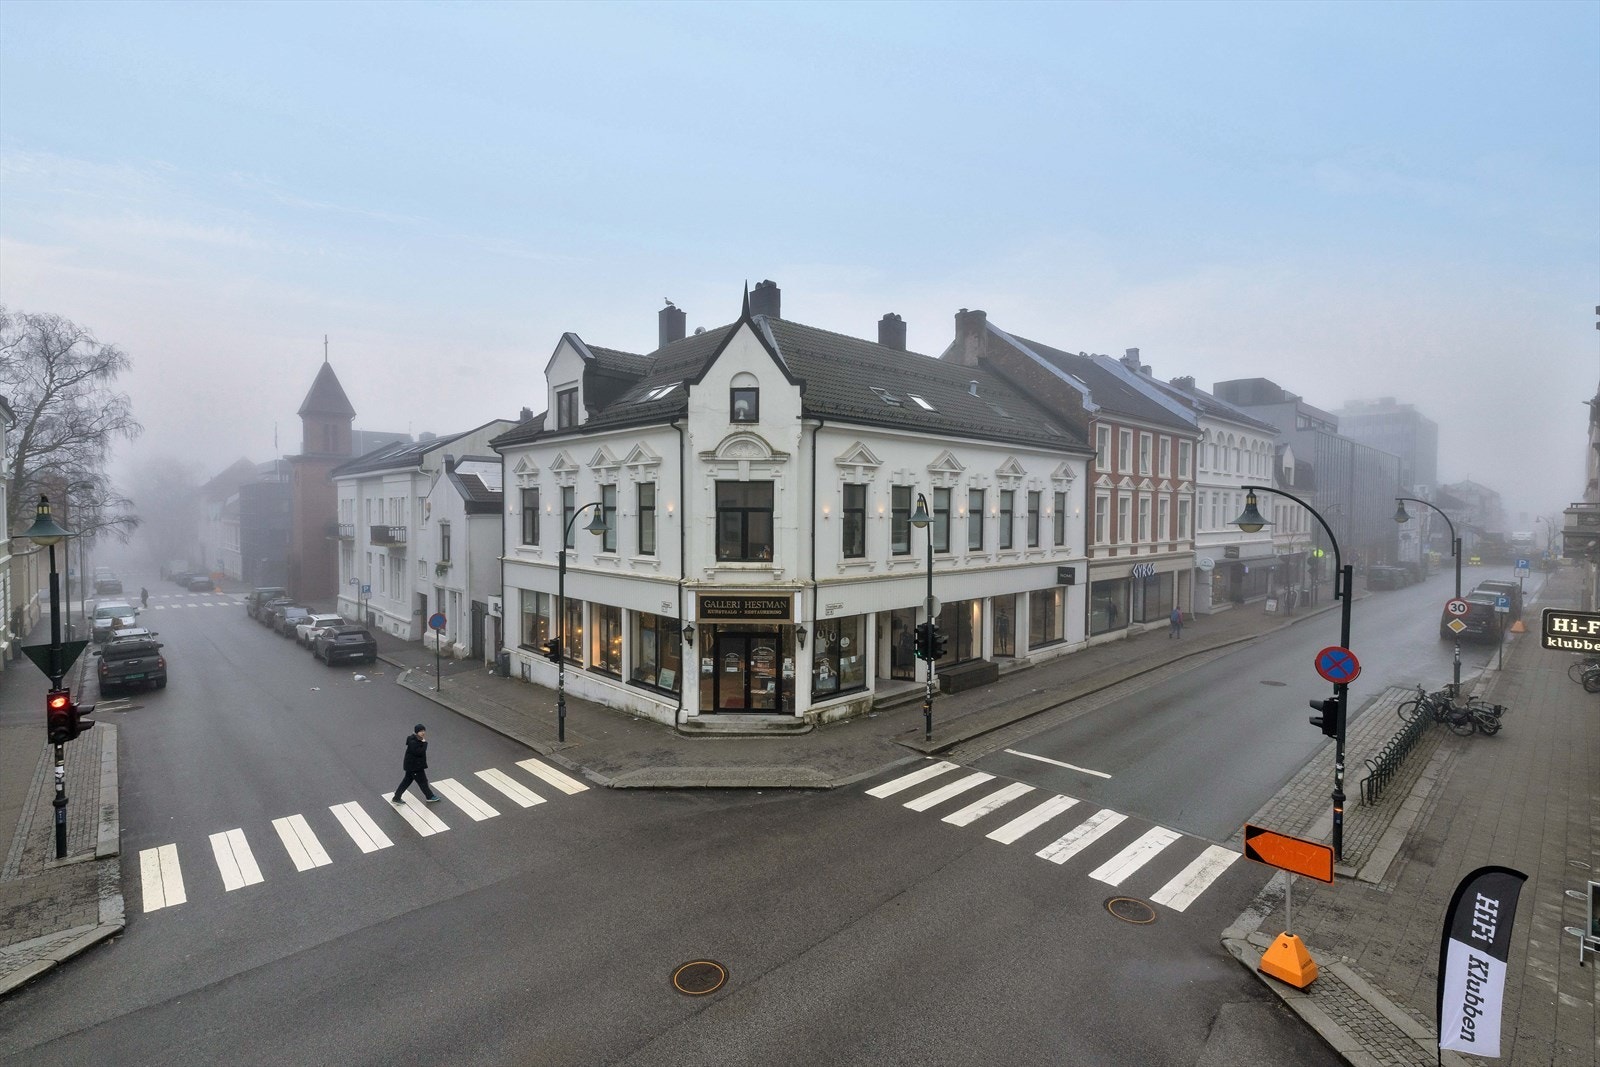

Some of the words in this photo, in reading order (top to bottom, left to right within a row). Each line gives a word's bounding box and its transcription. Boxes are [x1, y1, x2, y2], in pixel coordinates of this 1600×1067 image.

[1132, 563, 1155, 579] GYROS
[704, 600, 740, 608] GALLERI
[744, 600, 787, 609] HESTMAN
[1450, 603, 1466, 613] 30
[1471, 892, 1500, 945] HiFi
[1459, 953, 1490, 1043] Klubben
